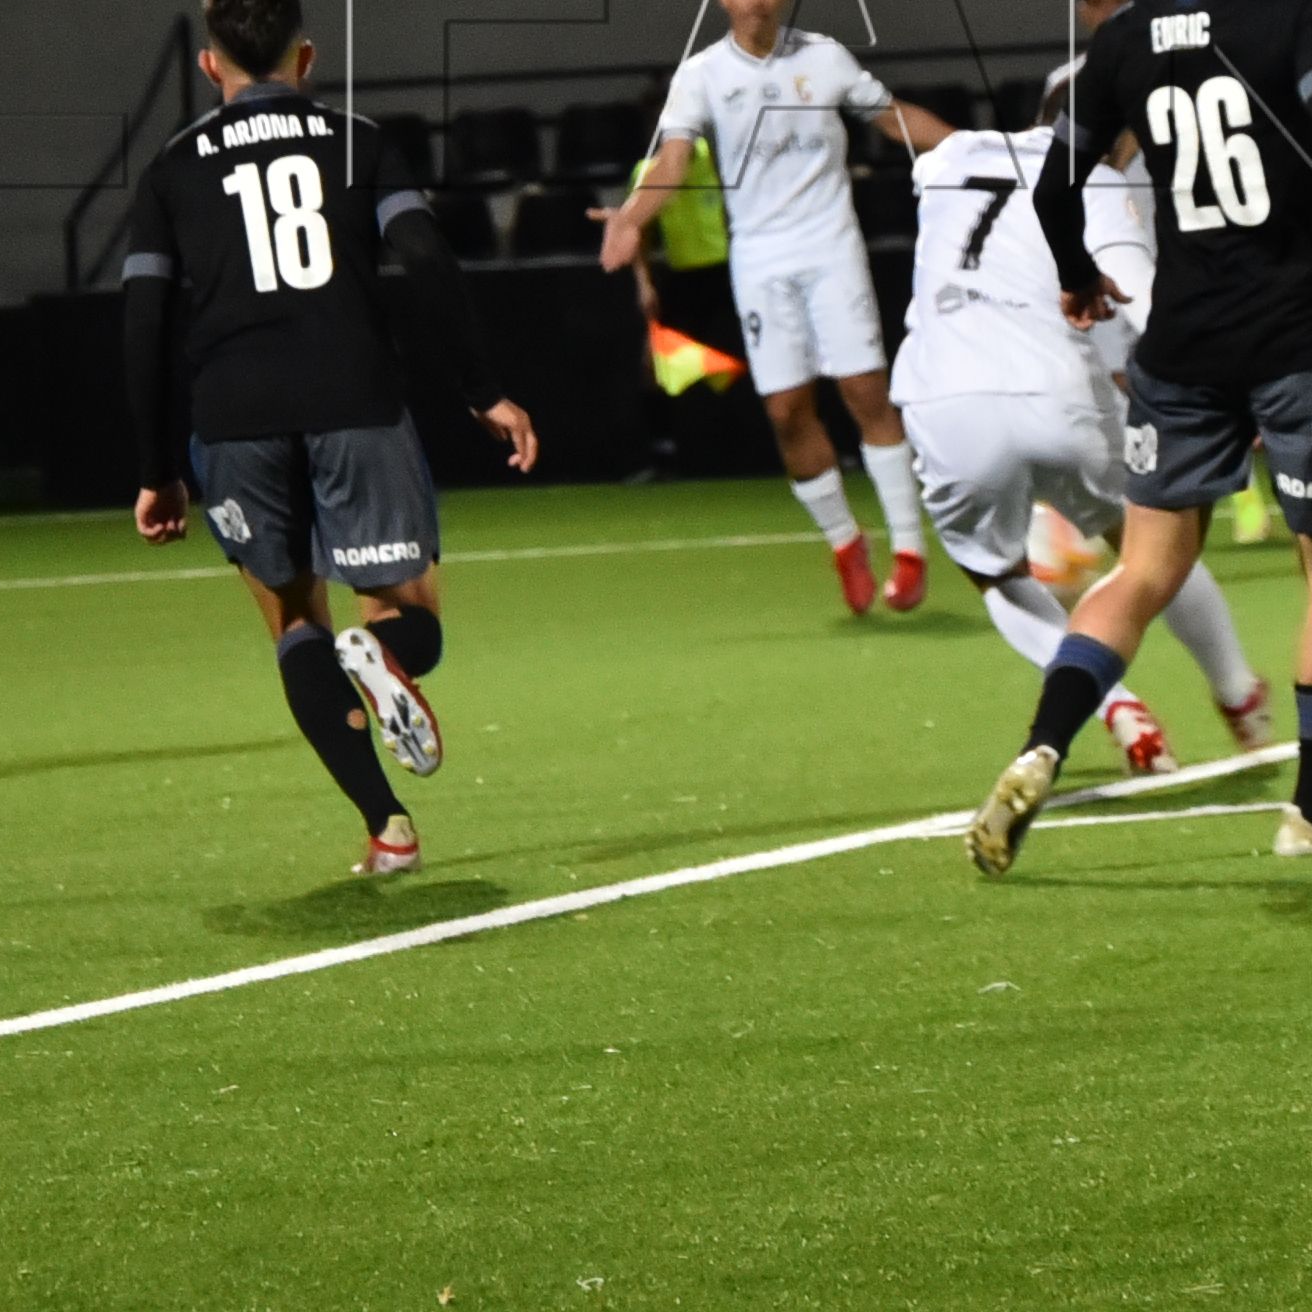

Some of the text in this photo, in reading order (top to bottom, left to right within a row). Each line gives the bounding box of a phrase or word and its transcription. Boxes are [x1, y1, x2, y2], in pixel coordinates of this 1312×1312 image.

[1151, 11, 1211, 54] ENRIC
[196, 133, 219, 157] A.
[222, 113, 304, 148] ARJONA
[1146, 75, 1271, 232] 26
[222, 154, 333, 292] 18
[959, 175, 1018, 270] 7
[332, 541, 421, 567] ROMERO
